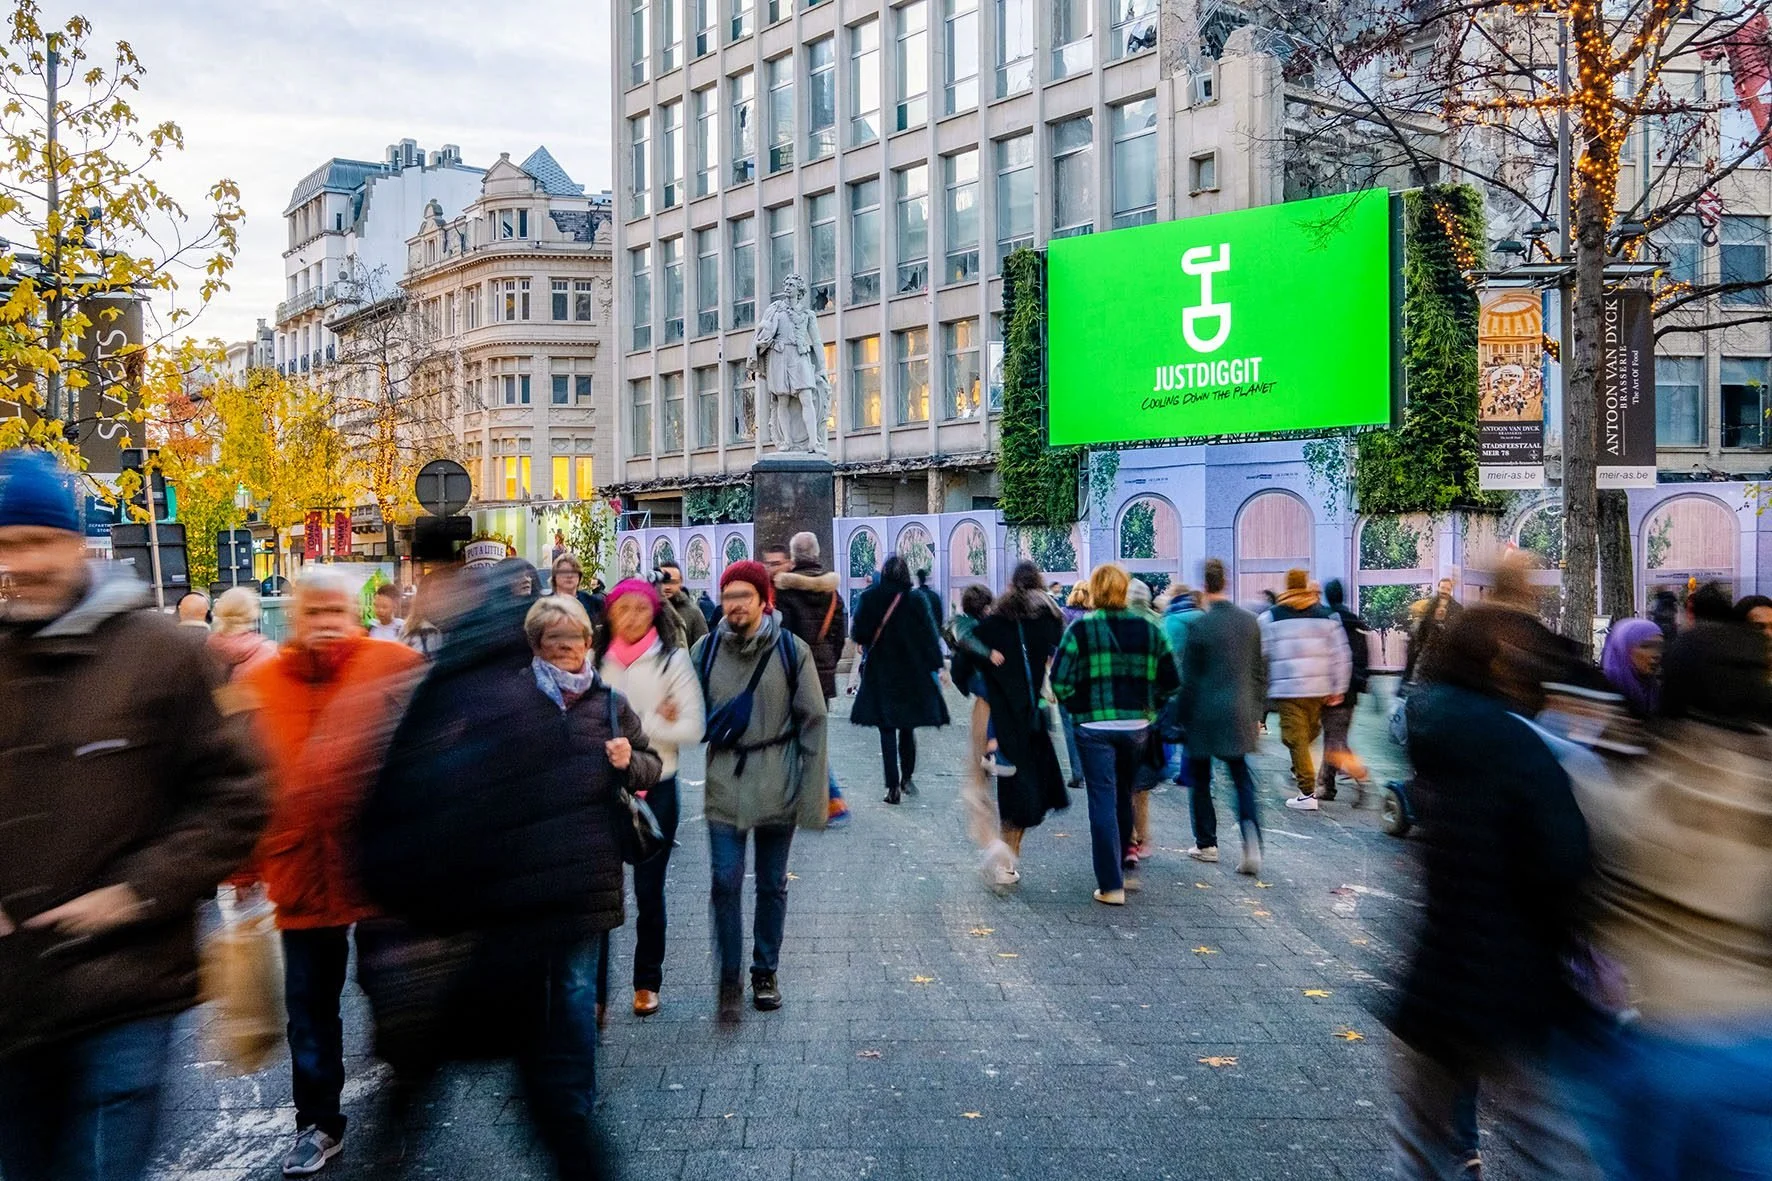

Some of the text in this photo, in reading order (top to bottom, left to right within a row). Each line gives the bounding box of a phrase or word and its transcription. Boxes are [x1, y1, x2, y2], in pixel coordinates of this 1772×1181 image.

[1153, 356, 1263, 392] JUSTDIGGIT
[1604, 298, 1619, 456] ANTOON VAN DYCK
[1619, 345, 1628, 409] BRASSERIE
[1631, 349, 1640, 405] The Art Of Food
[1141, 381, 1278, 411] COOLING DOWN THE PLANET
[1481, 442, 1542, 450] STADSFEESTZAAL
[1487, 470, 1537, 481] meir-as.be
[1598, 471, 1649, 481] meir-as.be
[337, 520, 345, 552] TOMMY
